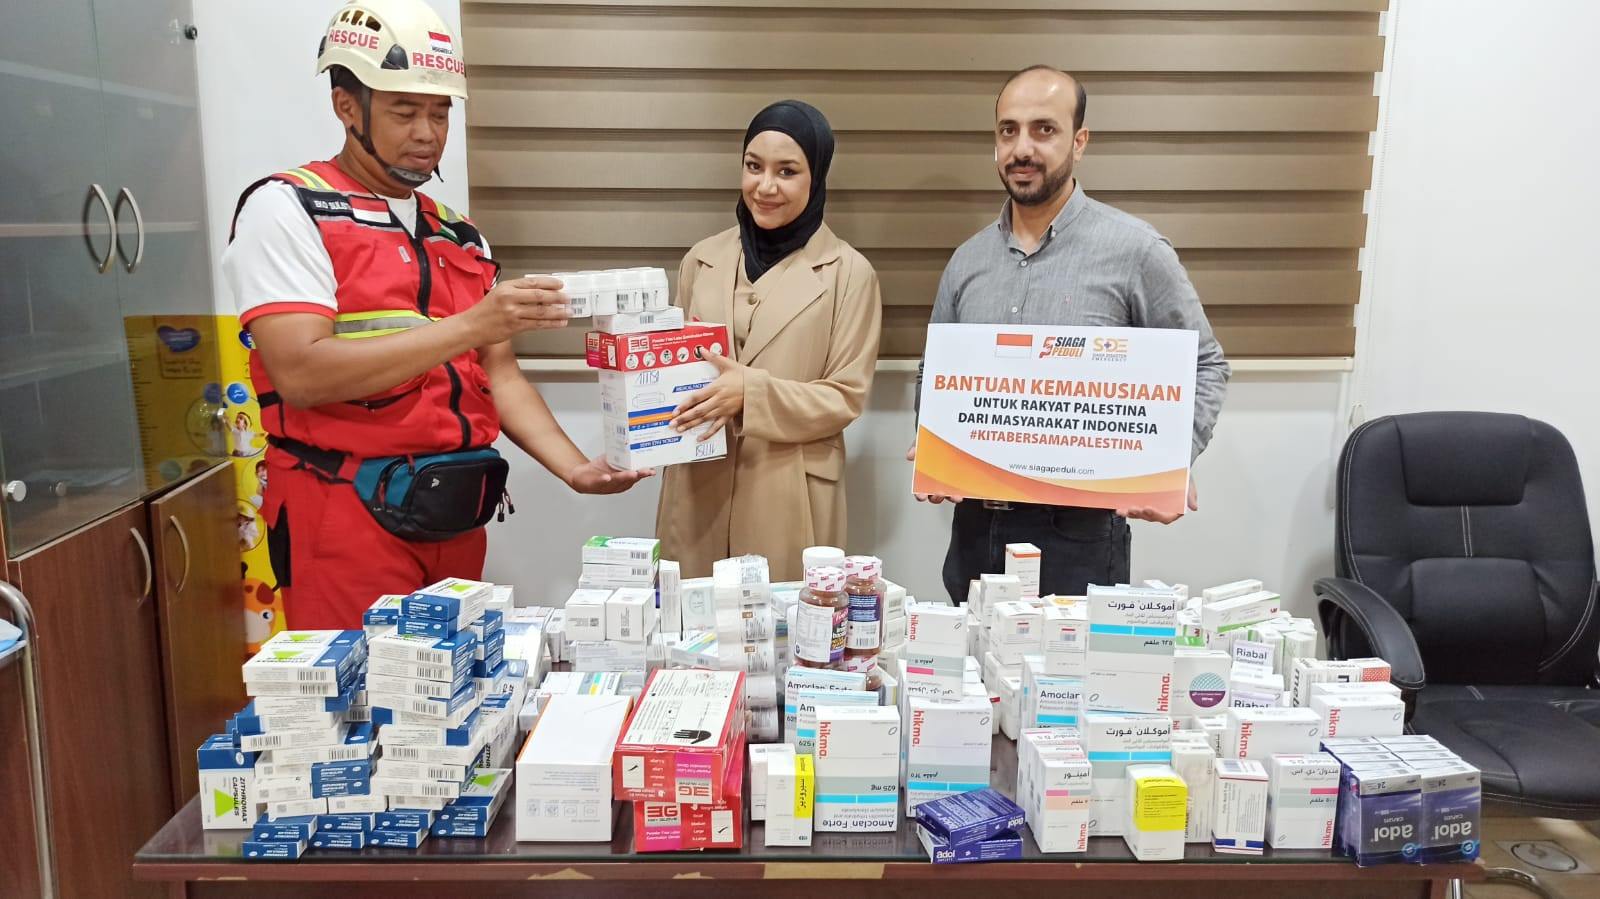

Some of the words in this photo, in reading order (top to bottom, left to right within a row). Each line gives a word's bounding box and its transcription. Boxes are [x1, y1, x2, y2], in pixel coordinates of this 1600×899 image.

[329, 30, 380, 50] RESCUE
[412, 52, 464, 74] RESCUE
[1055, 336, 1086, 348] SIAGA
[1052, 347, 1084, 358] PEDULI
[934, 374, 1026, 394] BANTUAN
[1030, 379, 1181, 402] KEMANUSIAAN
[973, 397, 1018, 410] UNTUK
[1021, 400, 1070, 413] RAKYAT
[1074, 402, 1147, 417] PALESTINA
[958, 412, 989, 425] DARI
[991, 414, 1078, 429] MASYARAKAT
[1082, 420, 1158, 435] INDONESIA
[970, 429, 1143, 451] #KITABERSAMAPALESTINA
[1009, 462, 1095, 476] www.siagapeduli.com
[1107, 600, 1135, 610] فورت
[1139, 600, 1175, 611] أموكلان
[1236, 647, 1267, 660] Riabal
[1328, 708, 1341, 738] hikm
[1106, 727, 1133, 737] فورت
[1136, 724, 1171, 736] أموكلان
[870, 784, 882, 792] mg
[882, 784, 896, 792] 625
[1377, 781, 1386, 789] 24
[1438, 779, 1446, 787] 24
[232, 776, 240, 817] CAPSULES
[239, 776, 248, 822] ZITHROMAX
[822, 819, 848, 828] Forte
[852, 819, 894, 828] Amoclan
[1374, 824, 1413, 842] adol
[1434, 821, 1472, 840] adol
[936, 849, 956, 859] adol
